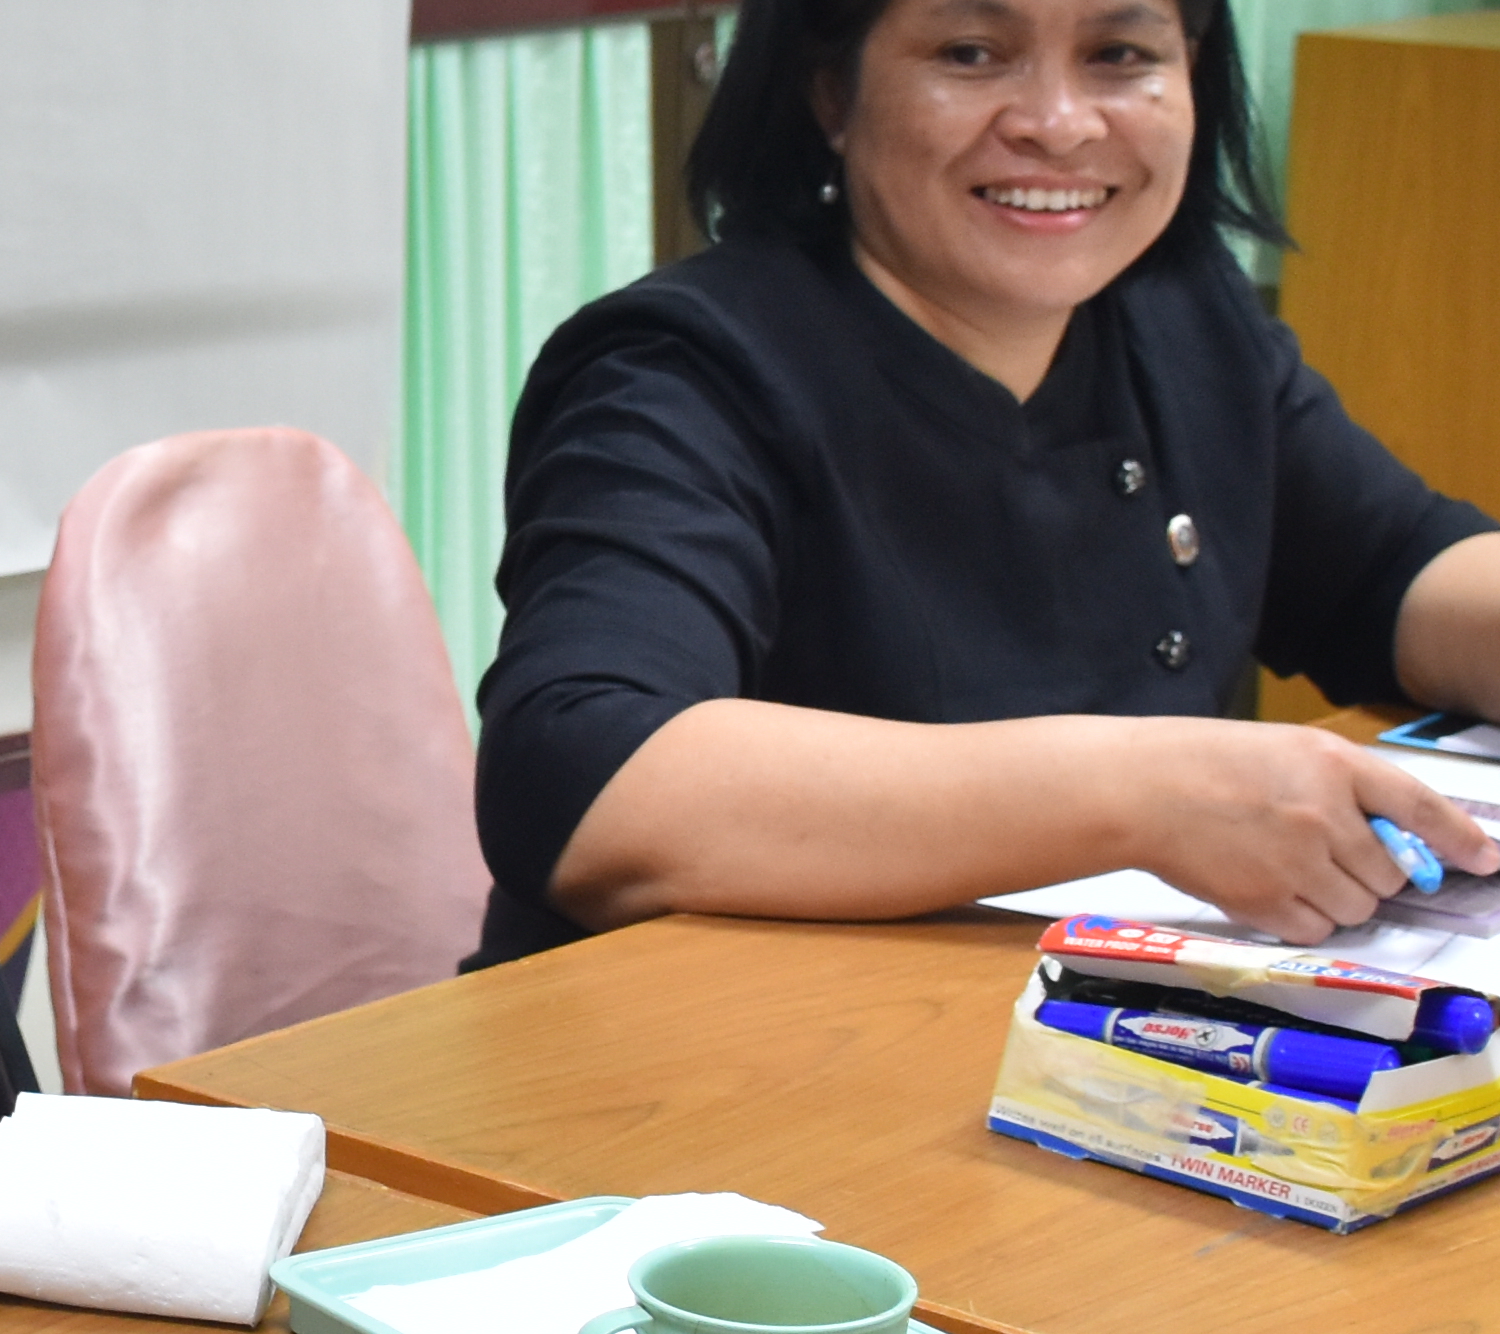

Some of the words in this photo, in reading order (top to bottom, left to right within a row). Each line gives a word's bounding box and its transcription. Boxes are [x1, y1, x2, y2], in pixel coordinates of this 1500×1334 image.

[1171, 1154, 1214, 1177] TWIN
[1217, 1166, 1292, 1200] MARKER
[1304, 1197, 1338, 1214] DOZEN
